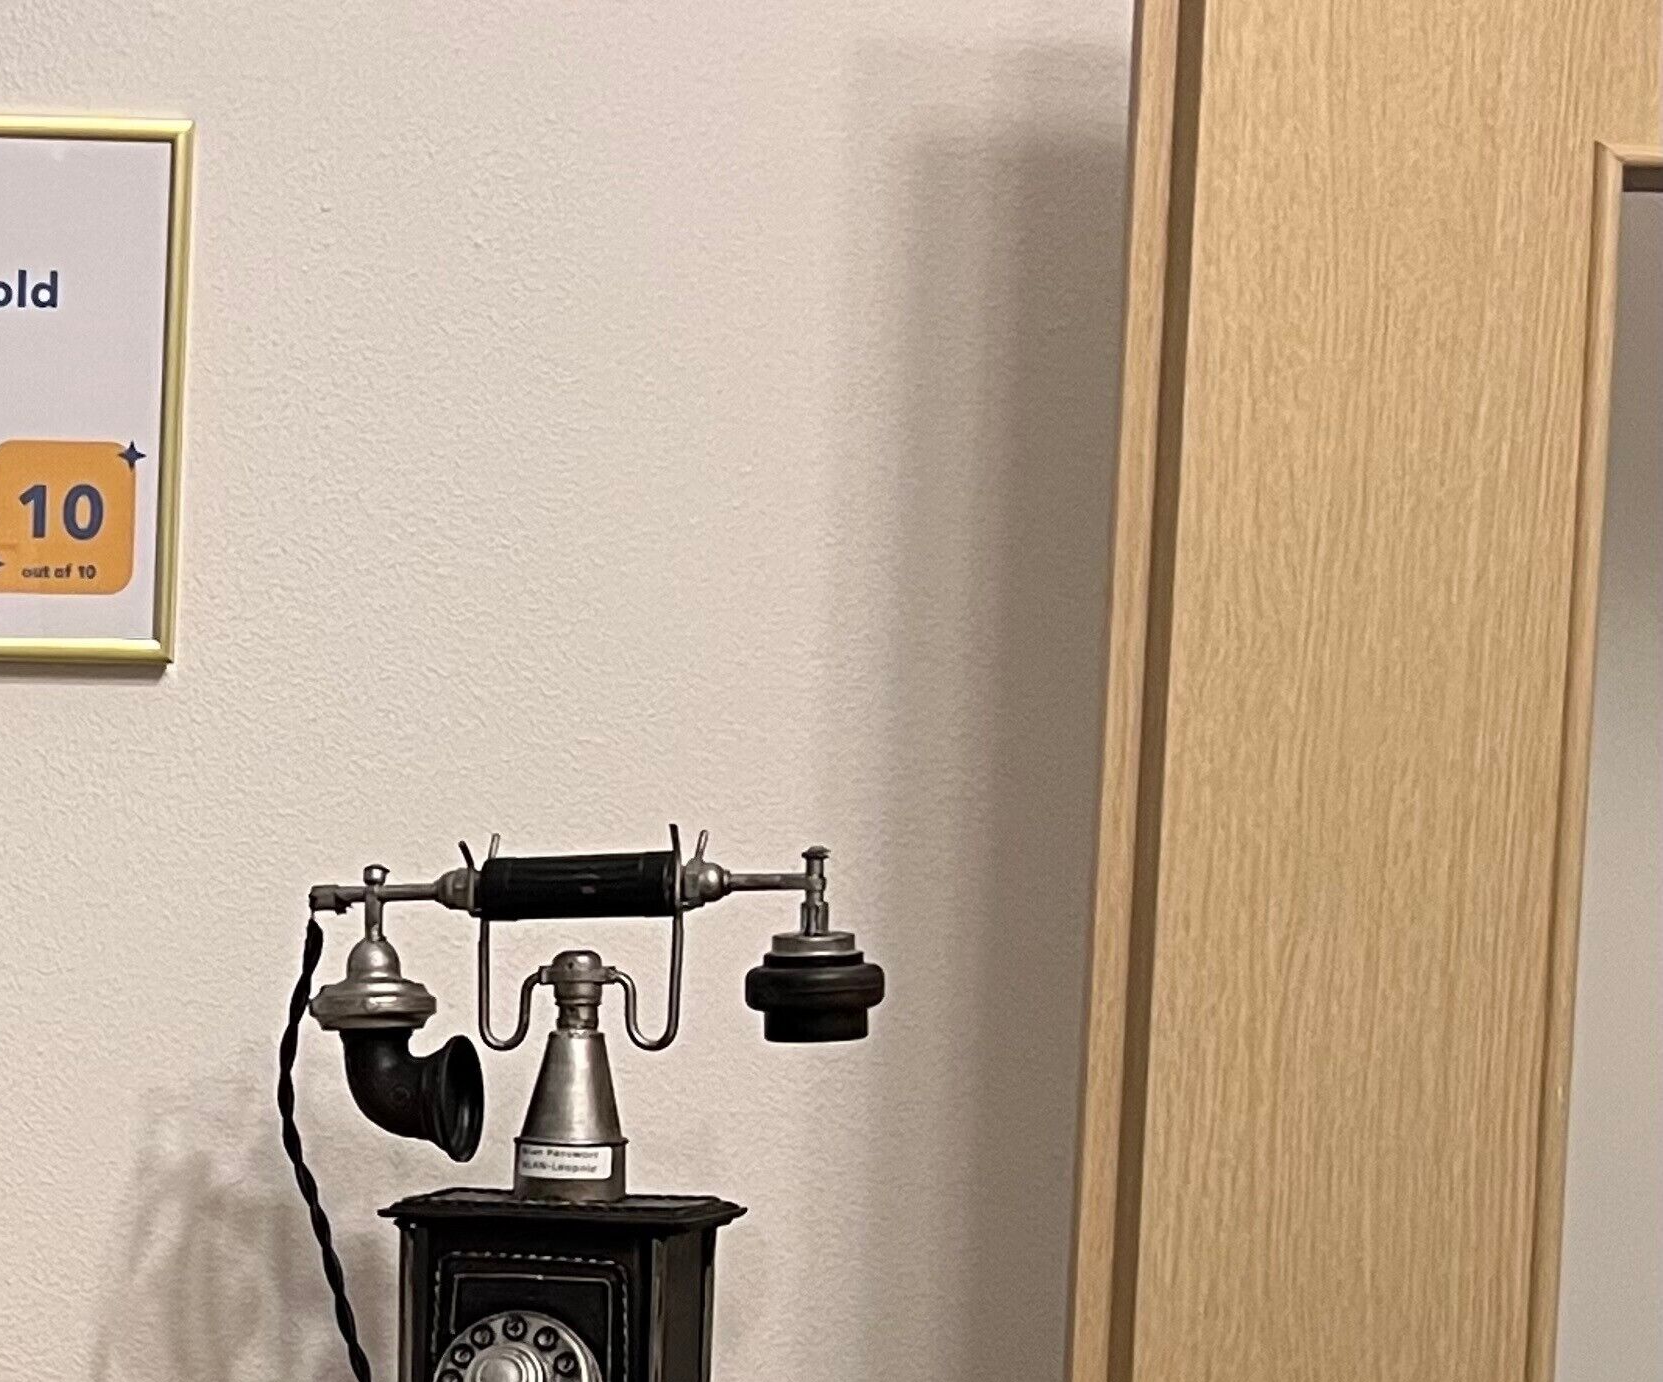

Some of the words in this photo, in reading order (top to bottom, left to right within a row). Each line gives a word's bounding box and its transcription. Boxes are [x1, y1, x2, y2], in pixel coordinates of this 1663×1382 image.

[18, 483, 104, 541] 10
[21, 565, 51, 579] out
[53, 562, 73, 579] of
[77, 564, 97, 580] 10
